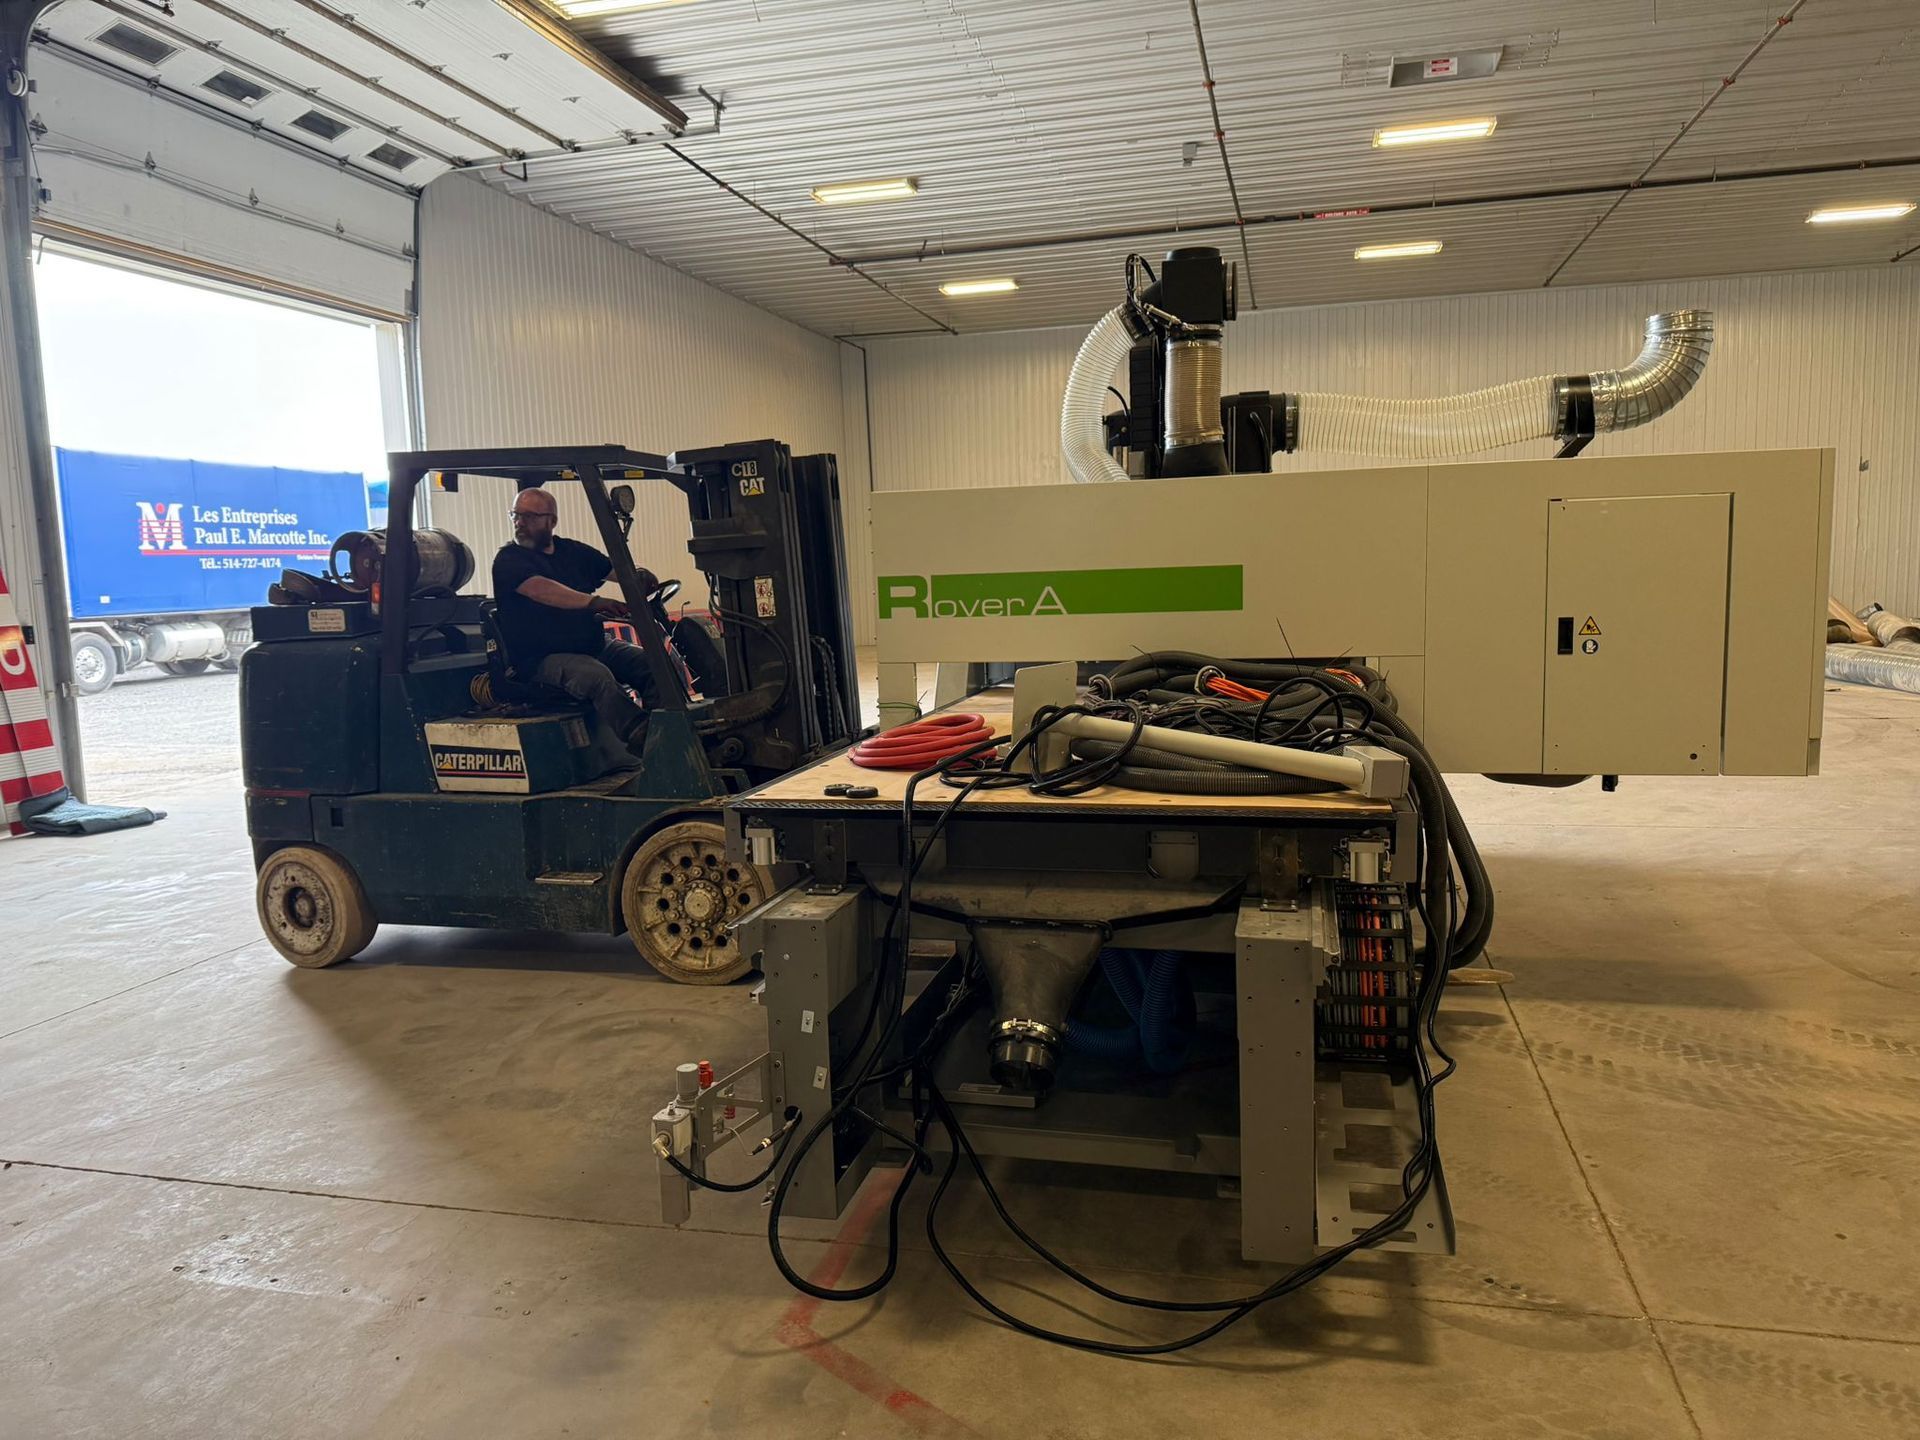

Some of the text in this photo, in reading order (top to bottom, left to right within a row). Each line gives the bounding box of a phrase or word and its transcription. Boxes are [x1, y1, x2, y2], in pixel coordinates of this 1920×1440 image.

[740, 477, 765, 497] CAT
[192, 505, 298, 529] Les Entreprises
[194, 527, 332, 546] Paul E. Marcotte Inc.
[877, 575, 1069, 619] Rover A
[434, 752, 522, 771] CATERPILLAR
